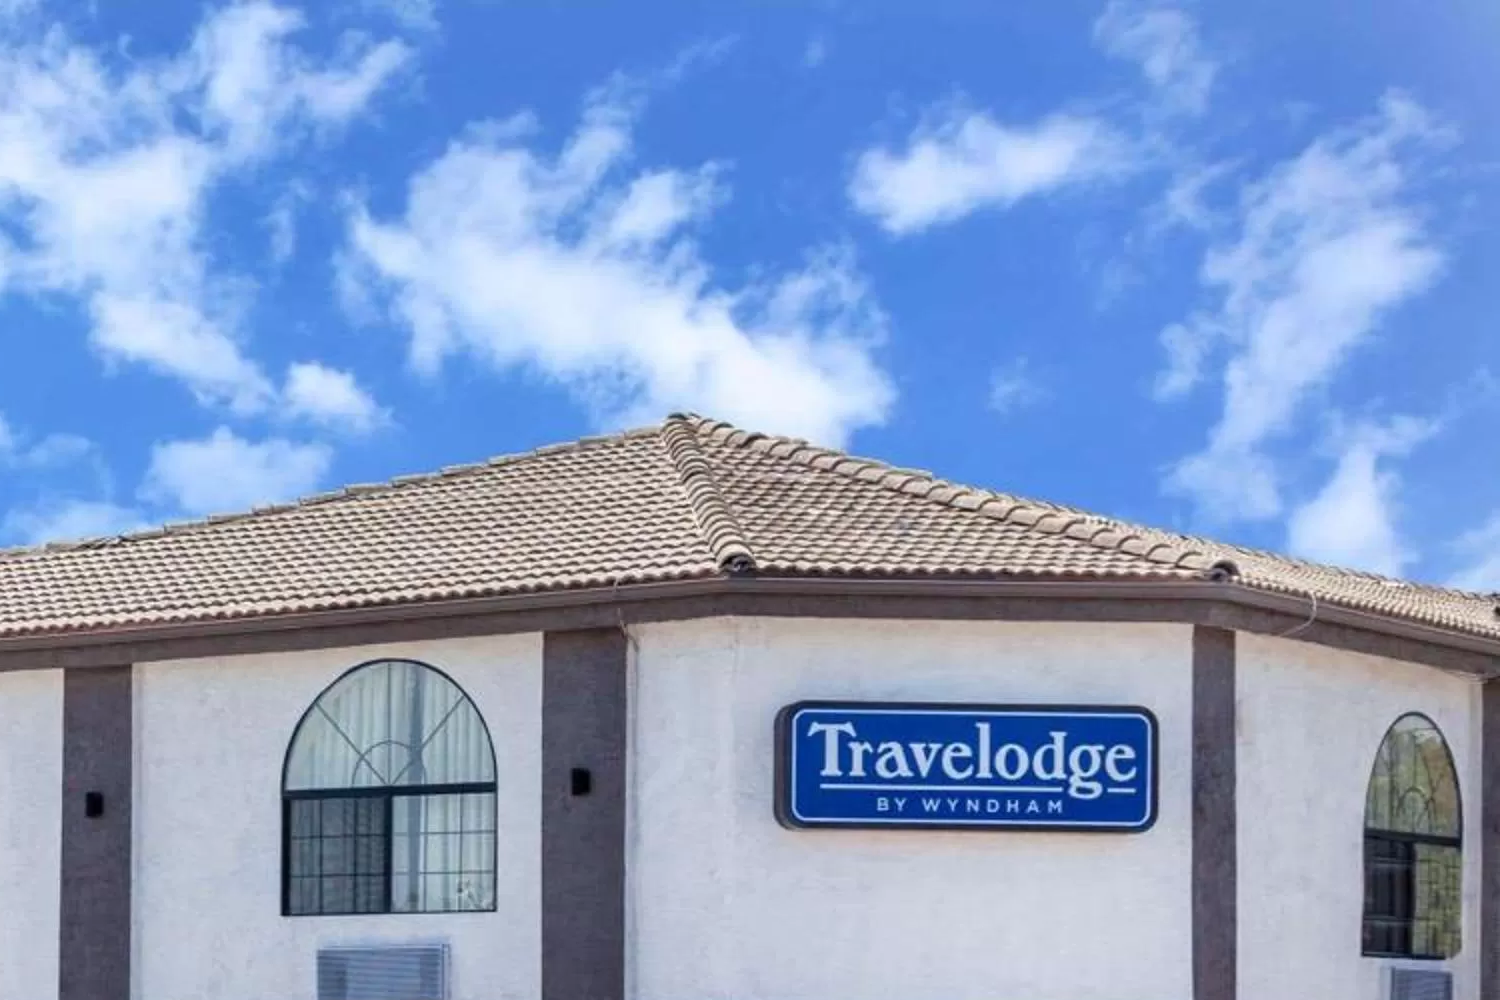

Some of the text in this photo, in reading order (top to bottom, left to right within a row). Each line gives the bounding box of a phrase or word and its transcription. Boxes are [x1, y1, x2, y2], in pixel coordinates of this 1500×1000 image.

[807, 721, 1137, 799] Travelodge
[876, 797, 1064, 814] BY WYNDHAM
